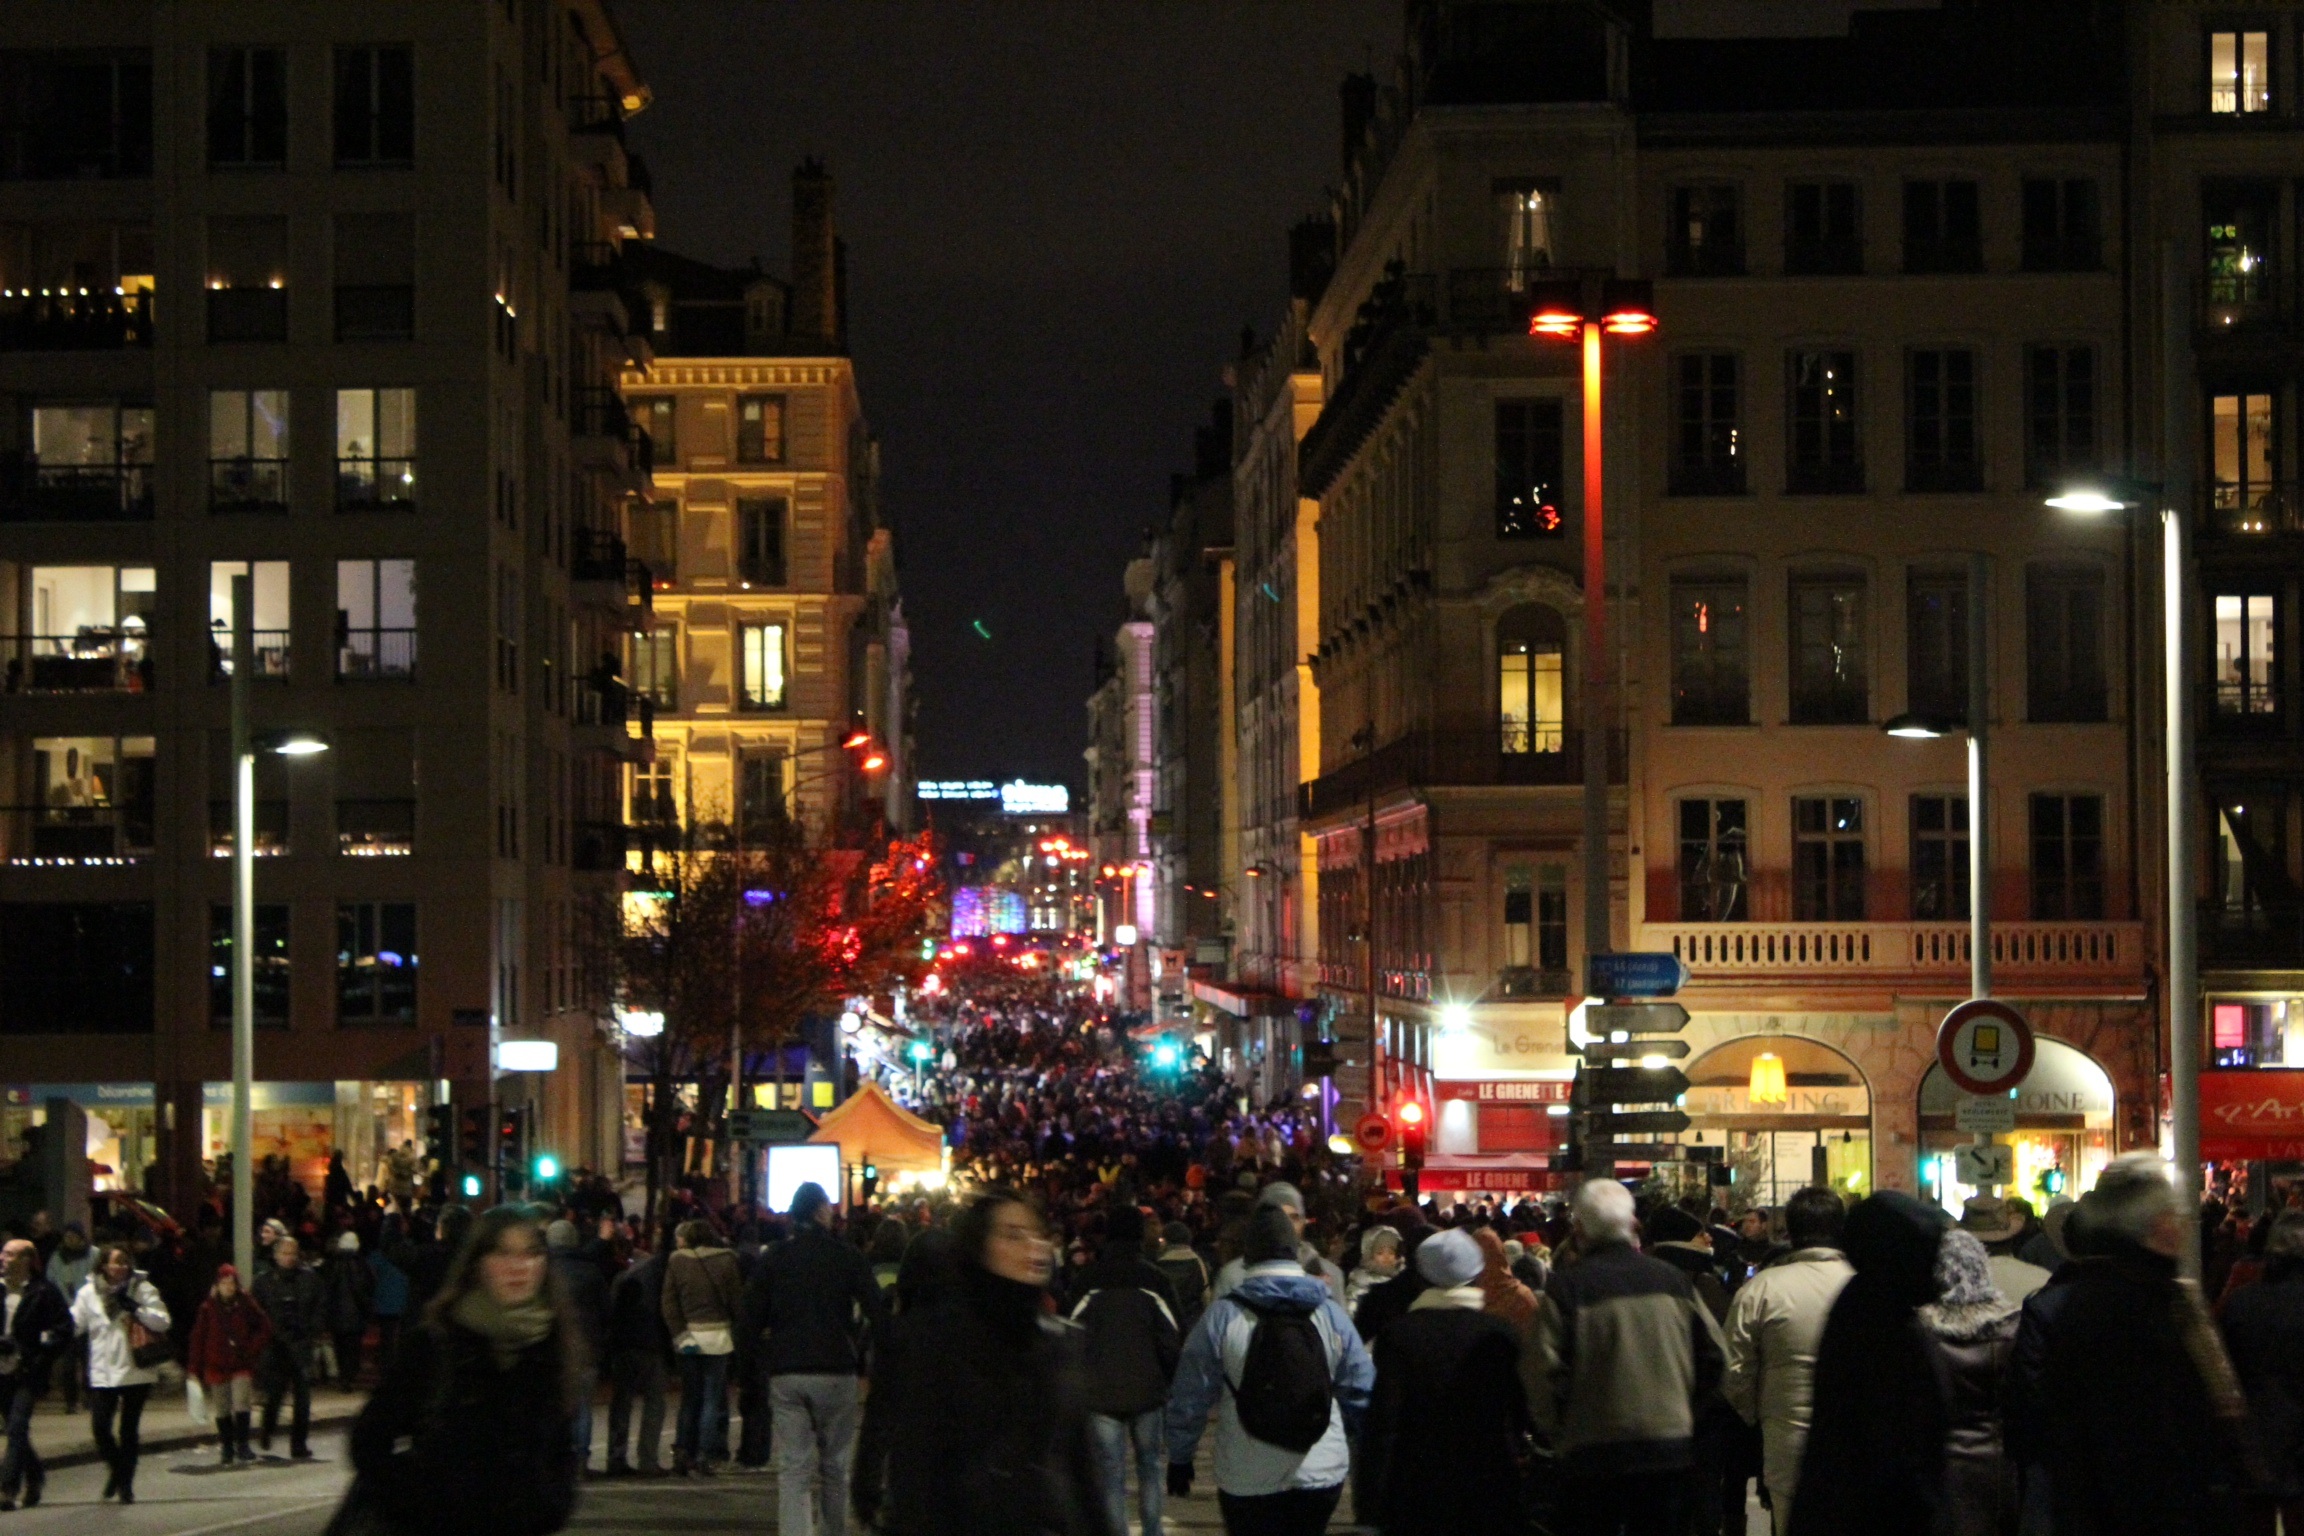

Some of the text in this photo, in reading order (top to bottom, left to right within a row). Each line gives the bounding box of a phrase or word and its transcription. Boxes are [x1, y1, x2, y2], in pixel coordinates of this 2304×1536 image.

[1493, 1035, 1511, 1054] Le
[1478, 1082, 1494, 1099] LE
[1496, 1082, 1564, 1099] GRENETTE
[1708, 1092, 1840, 1110] PRESSING
[1466, 1171, 1481, 1188] LE
